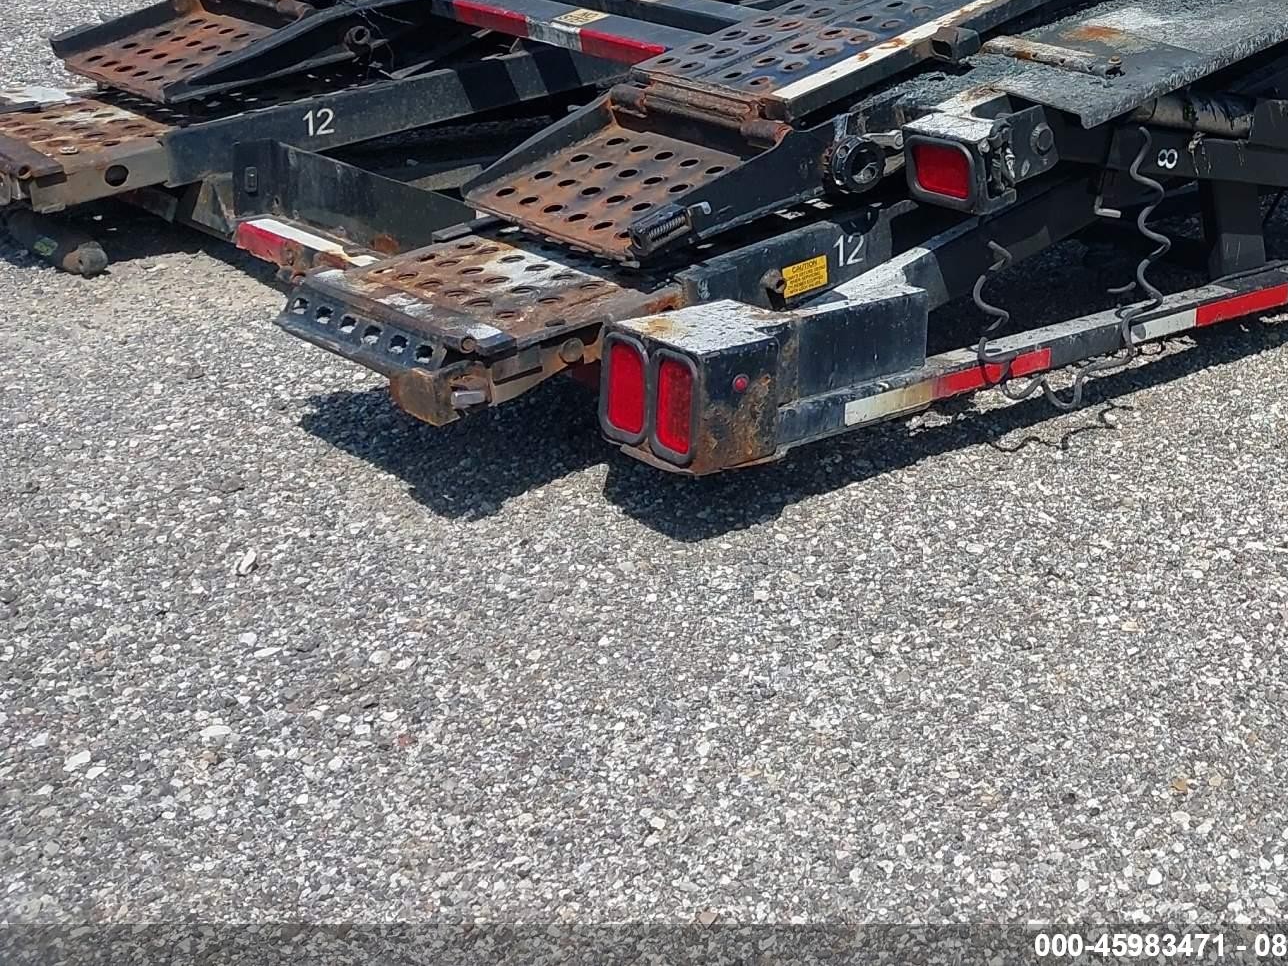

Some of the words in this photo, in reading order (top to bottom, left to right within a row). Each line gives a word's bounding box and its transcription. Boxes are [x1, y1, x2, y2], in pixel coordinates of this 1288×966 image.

[302, 107, 335, 136] 12
[1157, 148, 1178, 169] 8
[833, 233, 864, 267] 12
[791, 259, 818, 274] CAUTION
